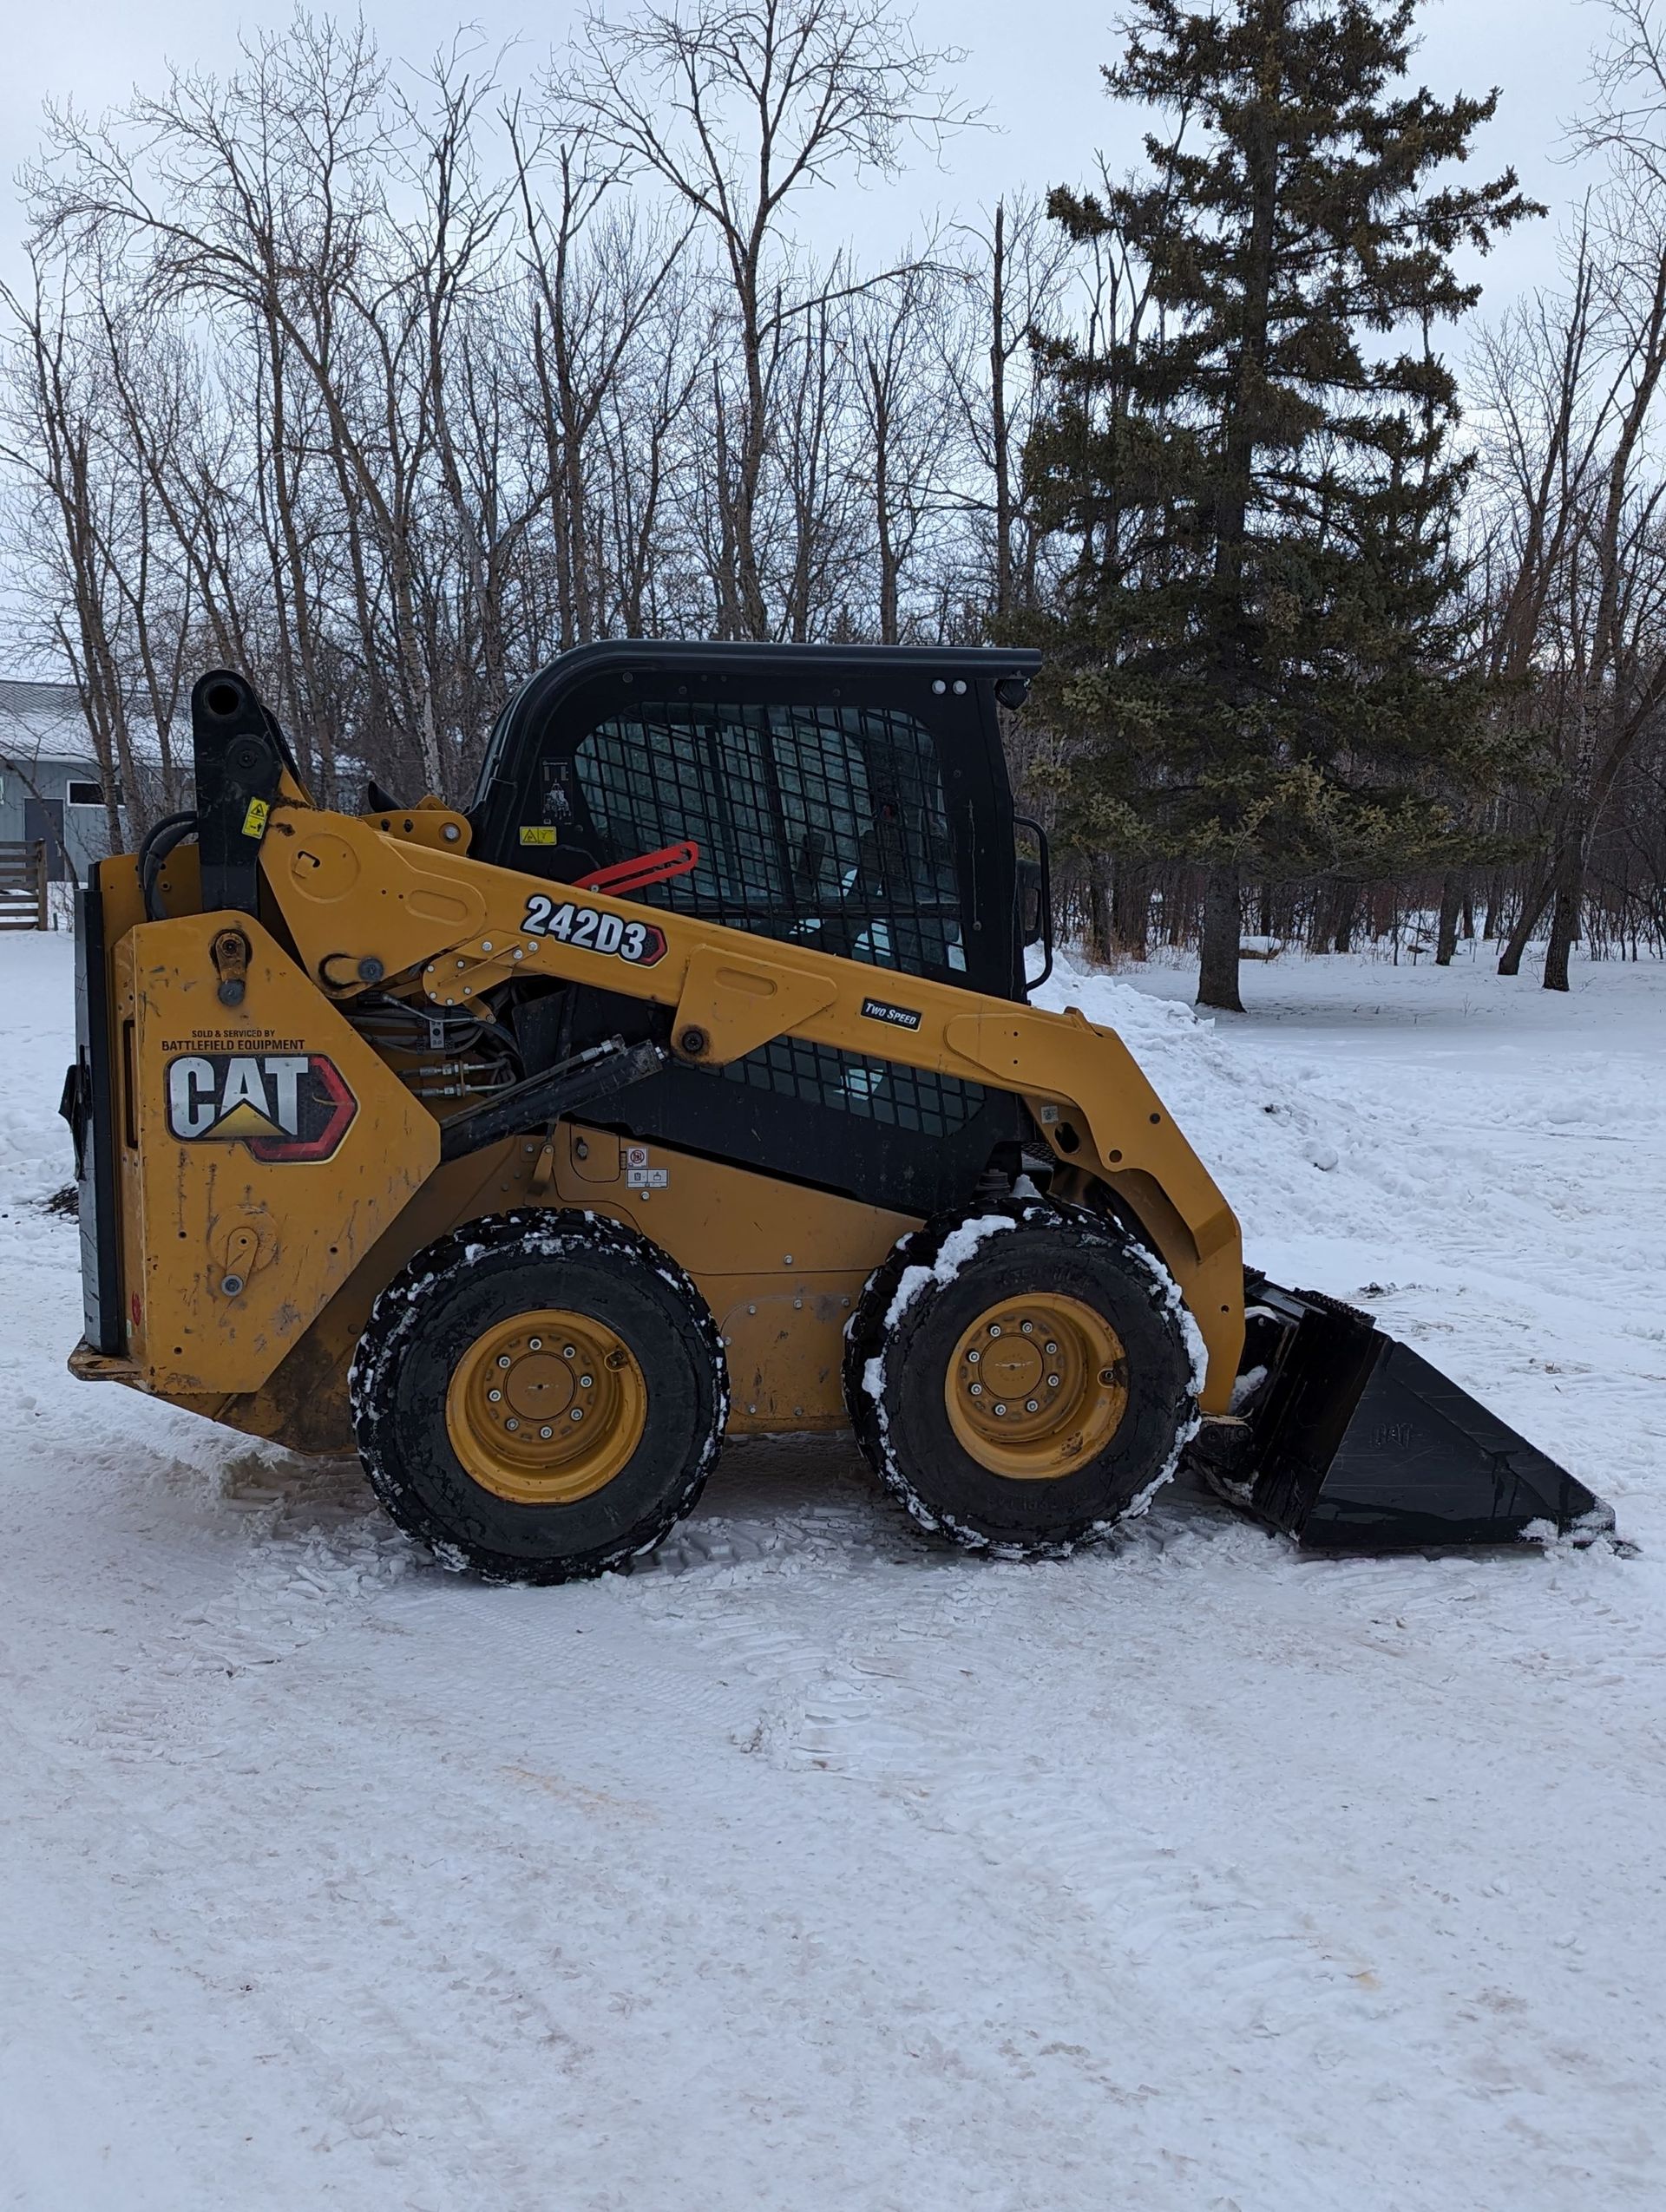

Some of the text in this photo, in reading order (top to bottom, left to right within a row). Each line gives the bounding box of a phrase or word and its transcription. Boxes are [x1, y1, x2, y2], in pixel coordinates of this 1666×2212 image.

[522, 896, 646, 959] 242D3
[865, 1003, 917, 1025] TWO SPEED
[161, 1039, 305, 1051] BATTLEFIELD EQUIPMENT
[192, 1030, 213, 1038] SOLD
[214, 1030, 221, 1038] &
[223, 1030, 261, 1038] SERVICED
[169, 1057, 309, 1138] CAT
